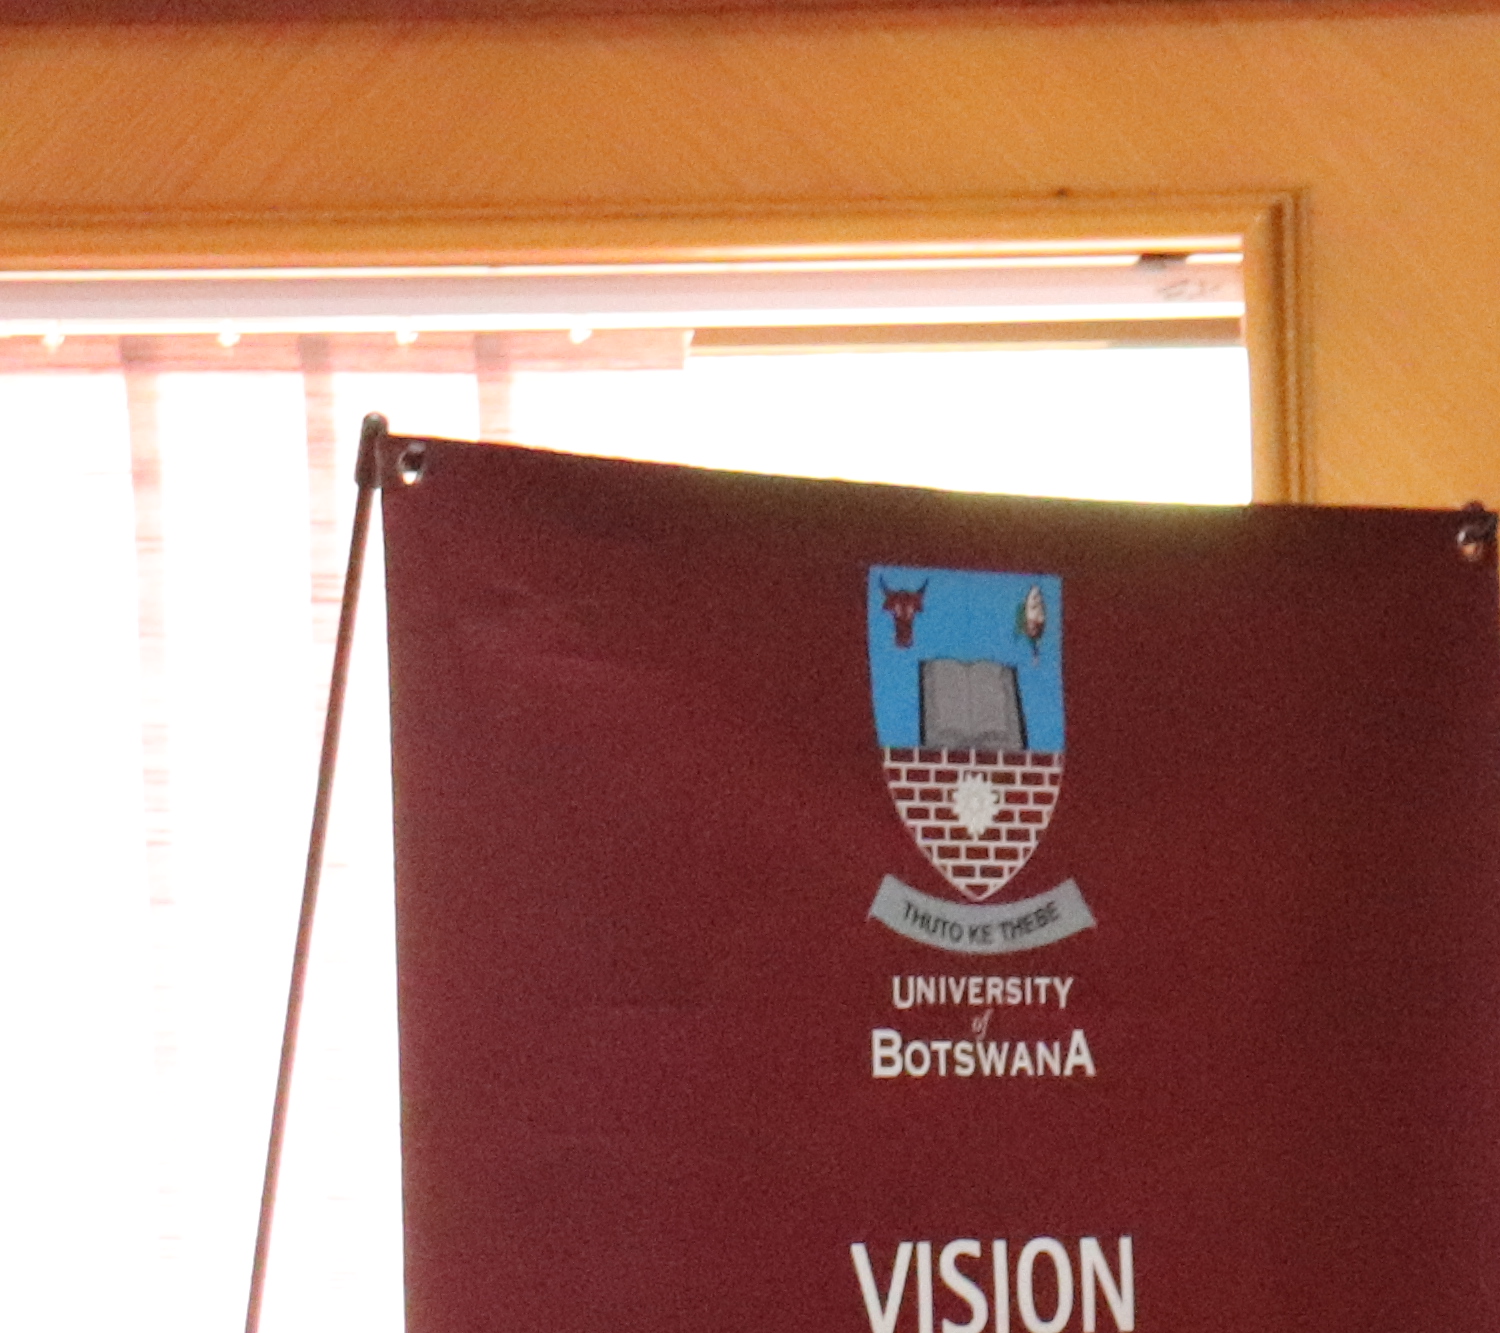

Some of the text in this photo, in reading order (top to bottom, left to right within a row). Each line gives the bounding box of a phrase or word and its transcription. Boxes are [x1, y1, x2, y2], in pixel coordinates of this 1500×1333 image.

[903, 900, 1061, 945] THUTO KE THEBE
[891, 974, 1075, 1011] UNIVERSITY
[970, 1008, 995, 1041] of
